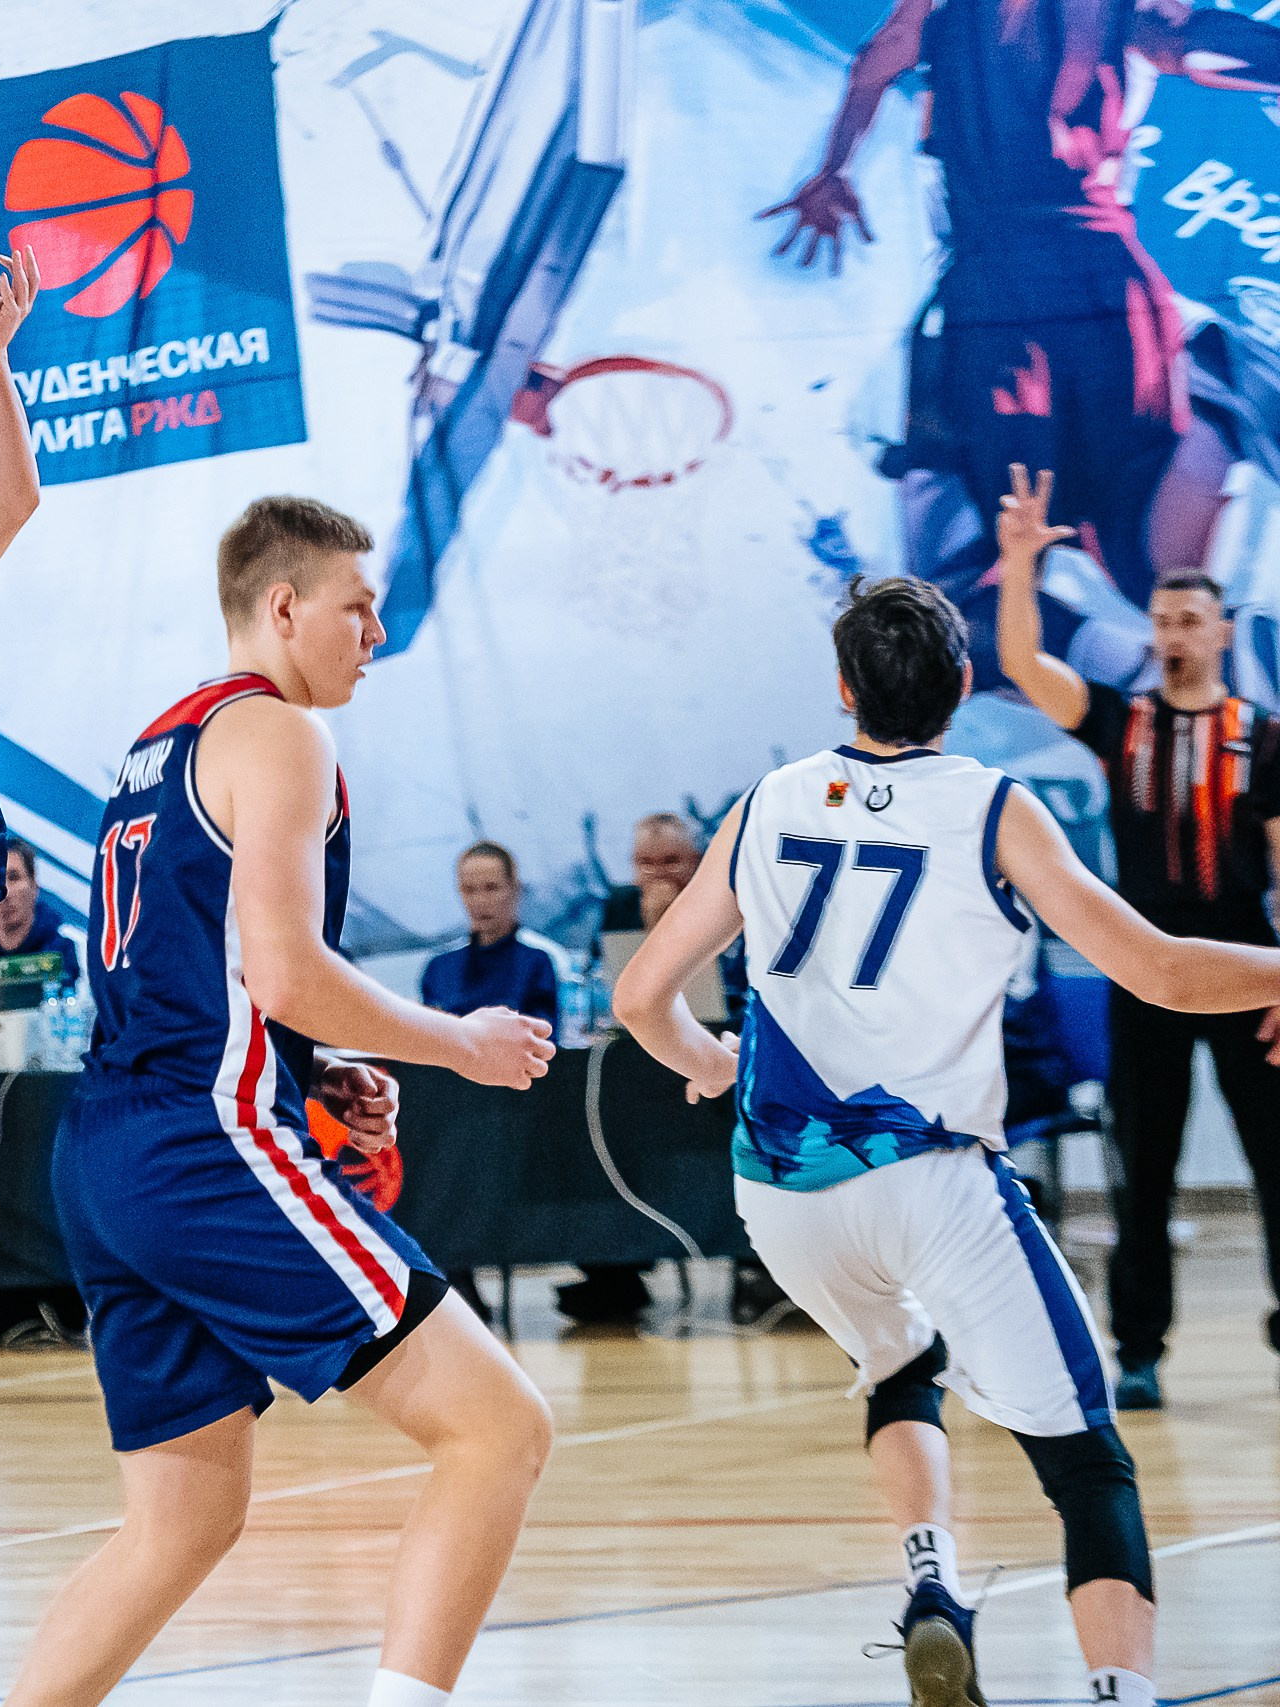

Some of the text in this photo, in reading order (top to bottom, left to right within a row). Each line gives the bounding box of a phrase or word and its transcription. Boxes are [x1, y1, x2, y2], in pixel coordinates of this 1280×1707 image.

[10, 327, 270, 407] УДЕНЧЕСКАЯ
[131, 390, 222, 436] РЖД
[100, 812, 158, 972] 17
[767, 832, 930, 991] 77
